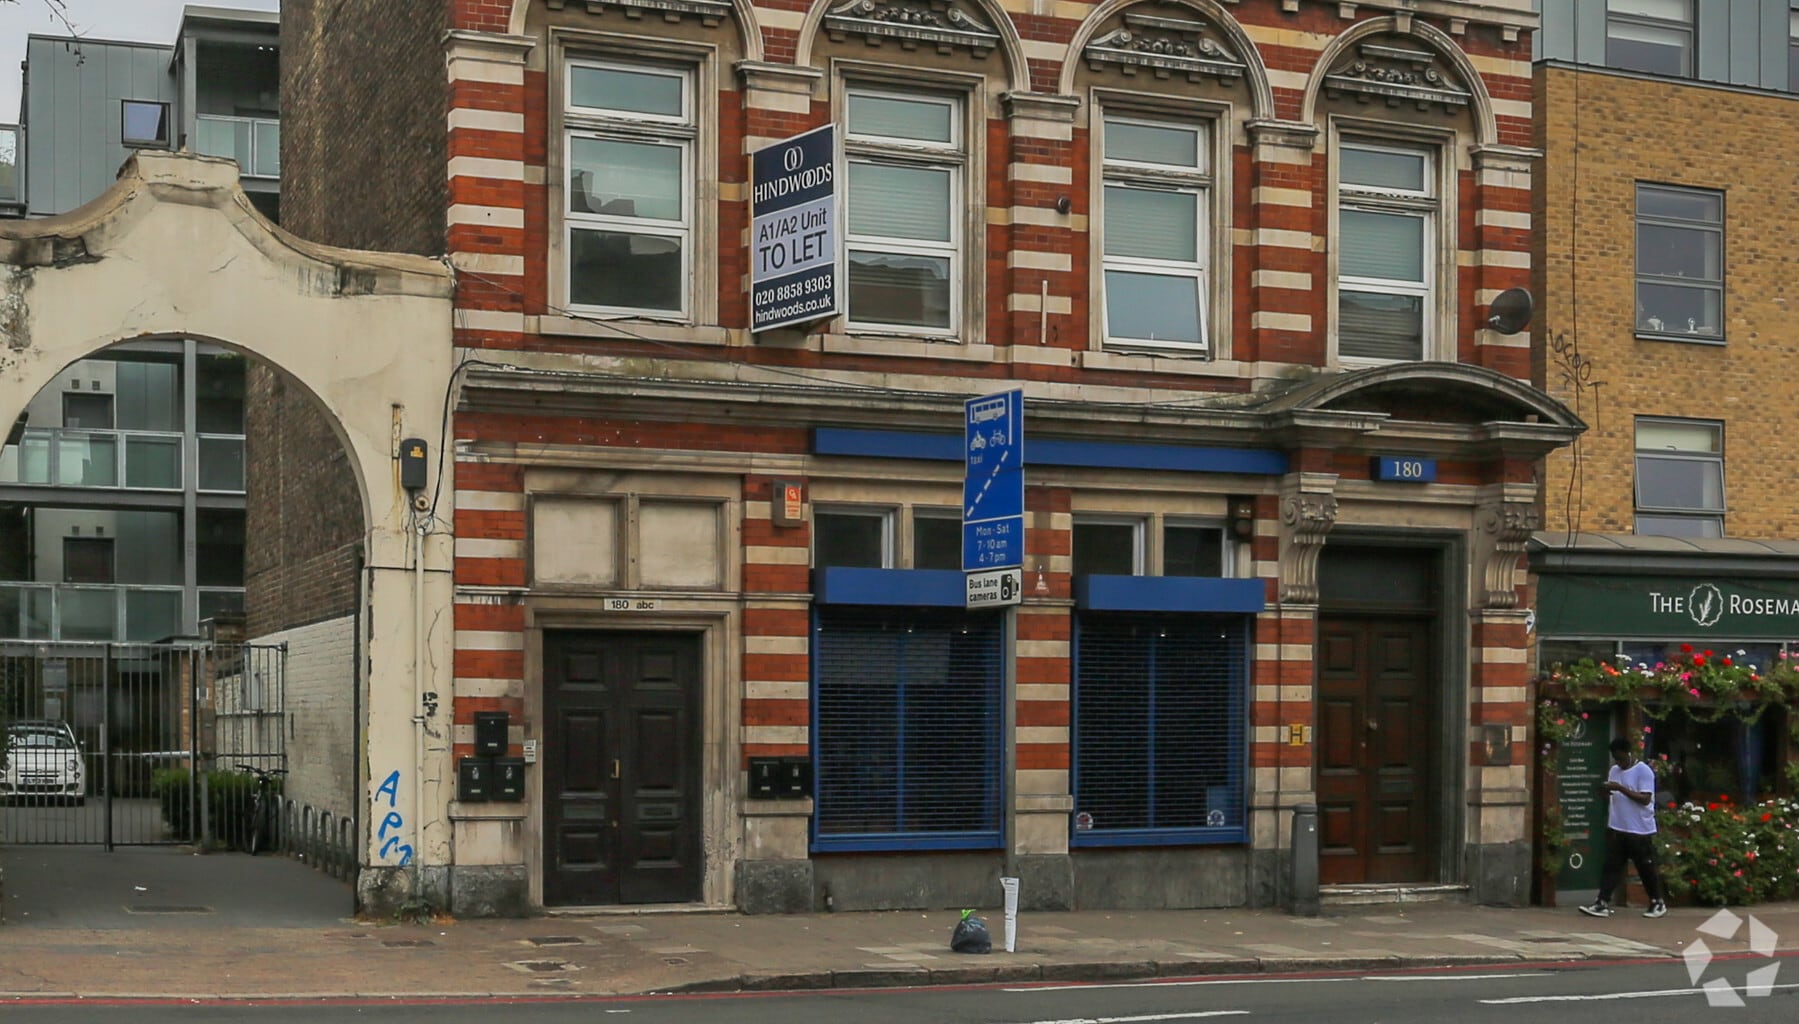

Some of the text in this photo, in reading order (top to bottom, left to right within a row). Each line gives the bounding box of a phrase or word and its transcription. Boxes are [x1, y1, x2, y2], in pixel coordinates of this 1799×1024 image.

[754, 162, 832, 204] HINDWOODS
[759, 207, 827, 243] A1/A2 Unit
[759, 229, 827, 273] TO LET
[755, 274, 832, 306] 020 8858 9303
[755, 294, 831, 323] hindwoods.co.uk
[970, 454, 983, 465] taxi
[1393, 461, 1422, 478] 180
[968, 577, 998, 590] Bus lane
[611, 600, 654, 609] 180 abc
[968, 591, 998, 602] cameras
[1649, 592, 1799, 616] THE ROSEMA
[1290, 725, 1303, 745] H
